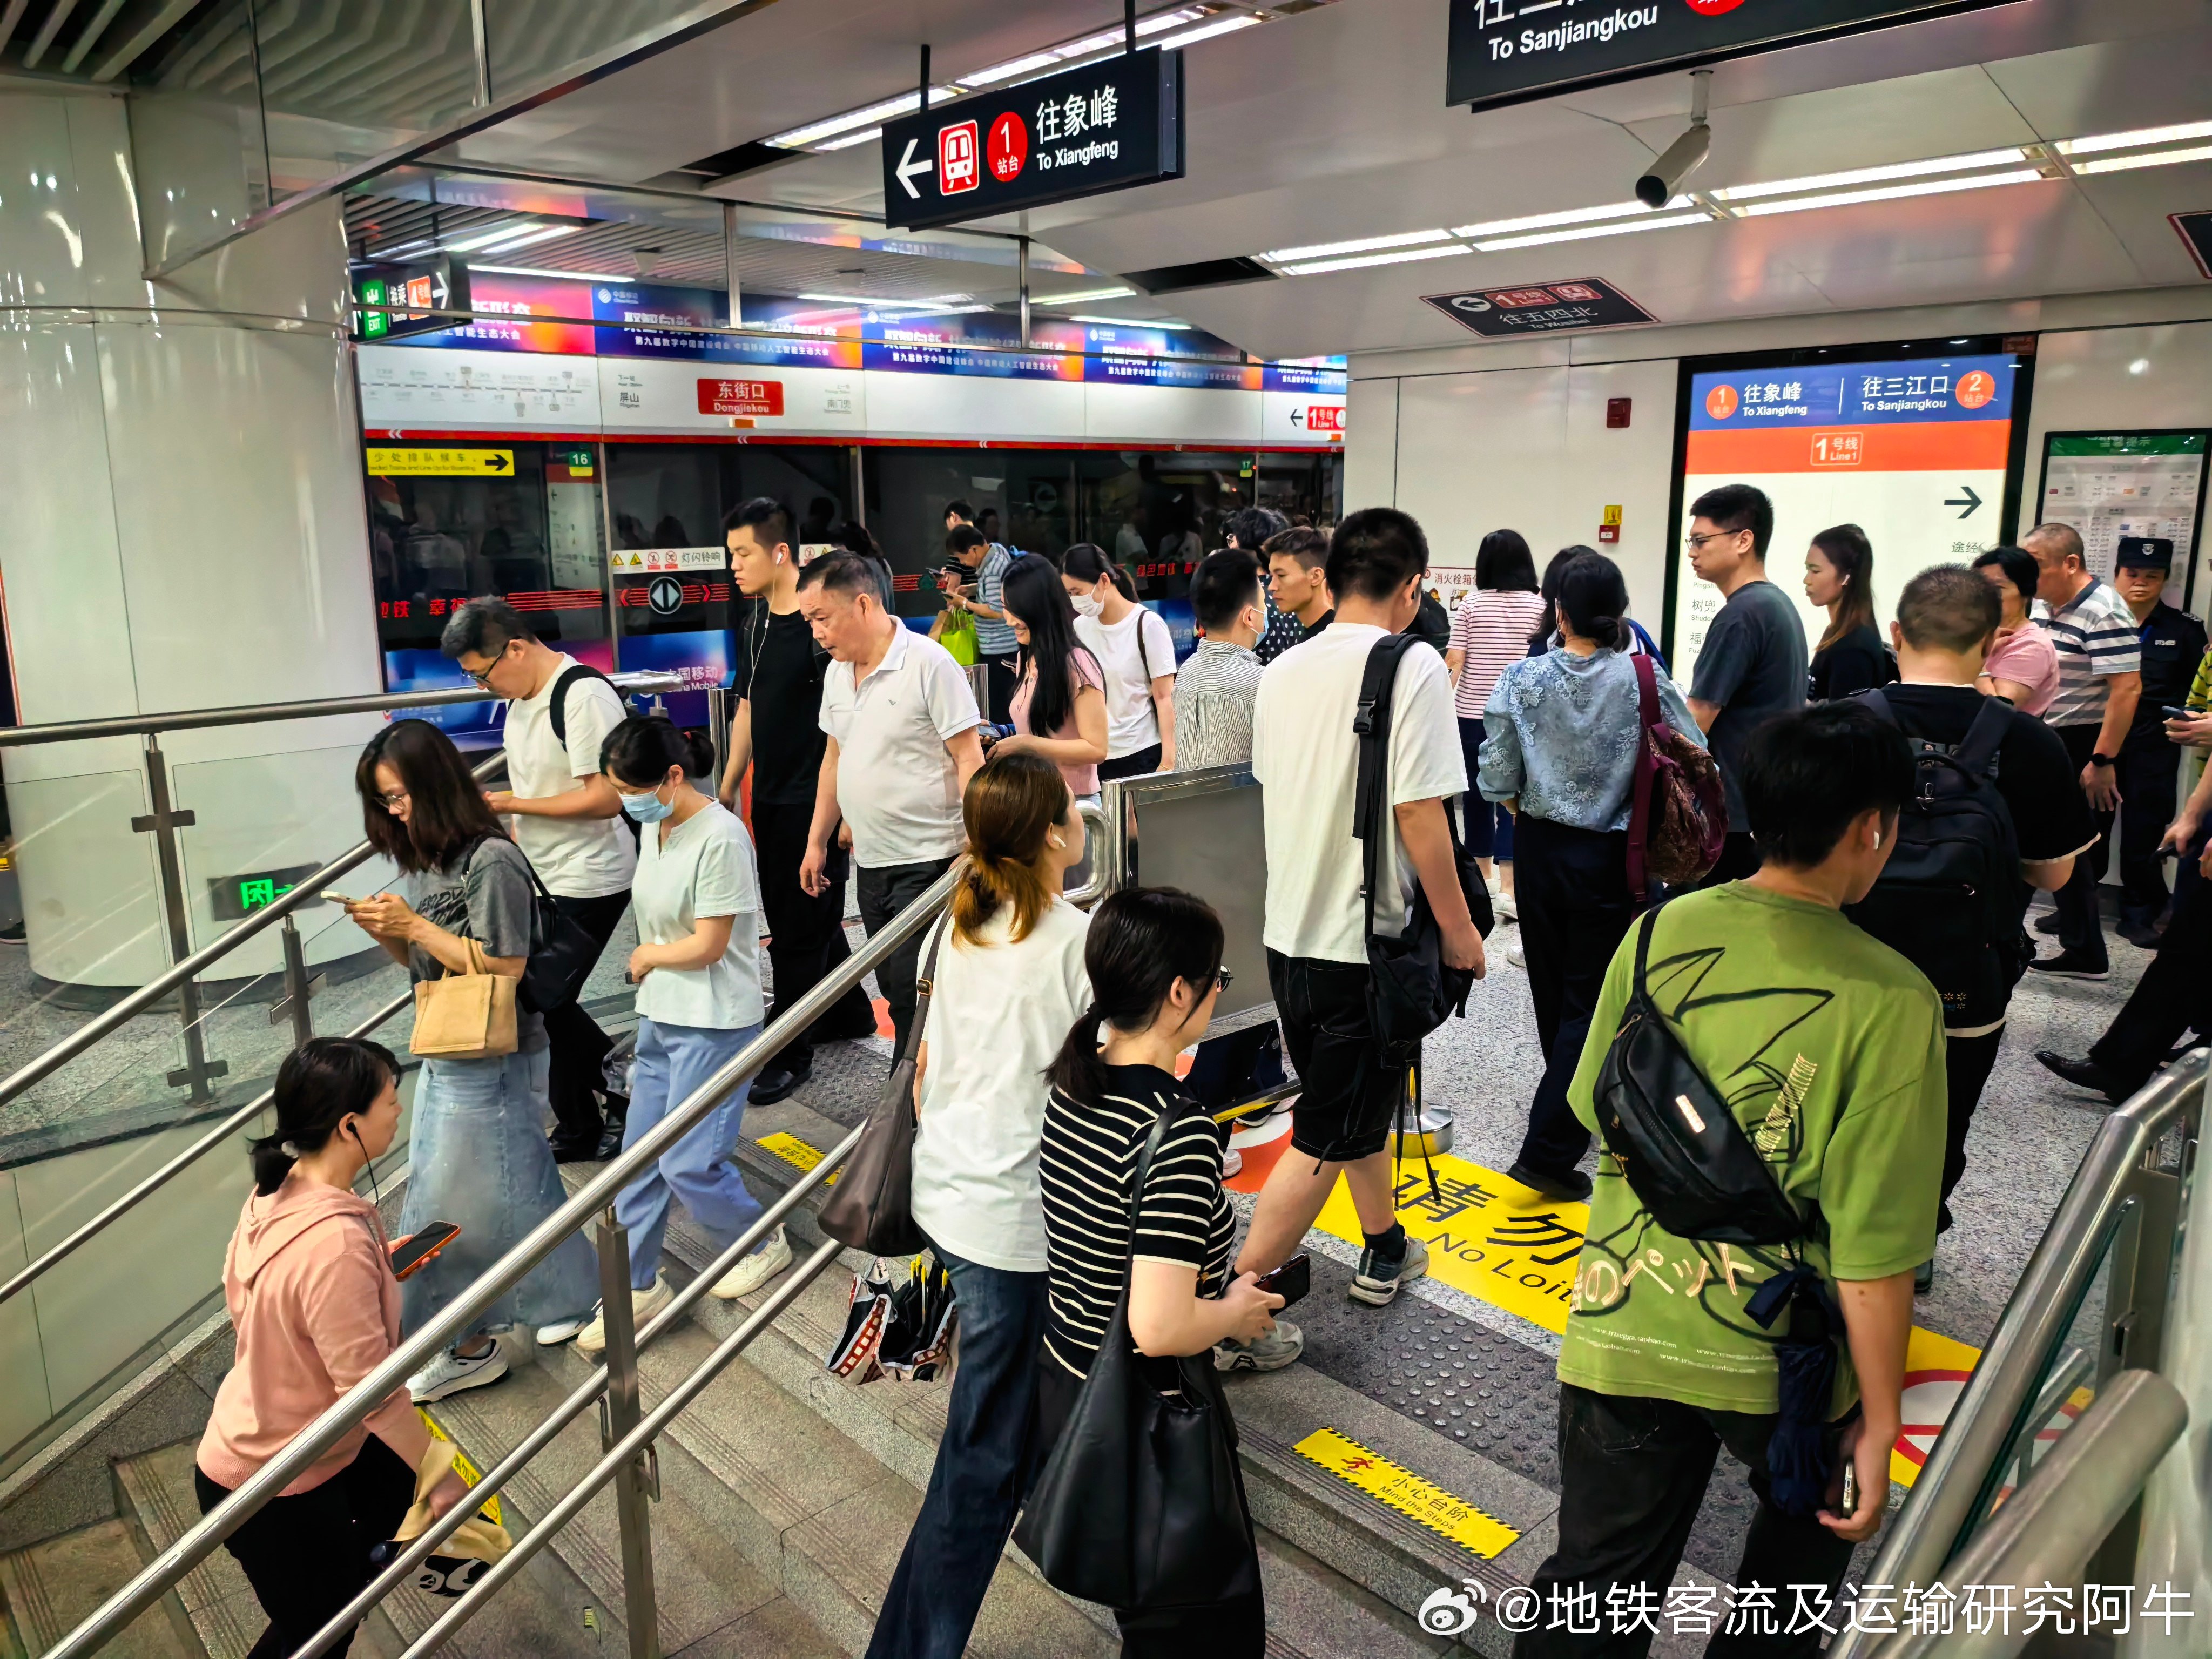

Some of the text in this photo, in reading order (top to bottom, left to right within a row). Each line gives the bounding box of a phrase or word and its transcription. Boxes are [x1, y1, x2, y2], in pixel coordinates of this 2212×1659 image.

[1489, 37, 1513, 60] To
[1519, 5, 1658, 54] Sanjiangkou
[1036, 84, 1119, 144] 往象峰
[1000, 121, 1010, 153] 1
[1036, 139, 1118, 171] To Xiangfeng
[997, 155, 1019, 175] 站台
[368, 318, 381, 331] EXIT
[1499, 306, 1599, 325] 往五四北
[718, 381, 765, 399] 东街口
[1863, 376, 1948, 399] 往三江口
[1968, 373, 1982, 392] 2
[1718, 387, 1725, 404] 1
[1743, 381, 1802, 404] 往象峰
[714, 402, 770, 415] Dongjiekou
[1743, 404, 1808, 417] To Xiangfeng
[1861, 399, 1947, 413] To Sanjiangkou
[1816, 437, 1858, 461] 1 号线
[1830, 451, 1857, 461] Line 1
[572, 453, 589, 465] 16
[682, 551, 721, 563] 灯闪铃响
[1951, 541, 1978, 554] 途经
[1692, 599, 1716, 612] 树兜
[1690, 632, 1705, 645] 福
[691, 681, 719, 691] Mobile
[1393, 1169, 1586, 1266] 请勿
[1426, 1232, 1486, 1262] No
[1379, 1486, 1455, 1530] Mind the Steps
[1391, 1478, 1469, 1522] 小心台阶
